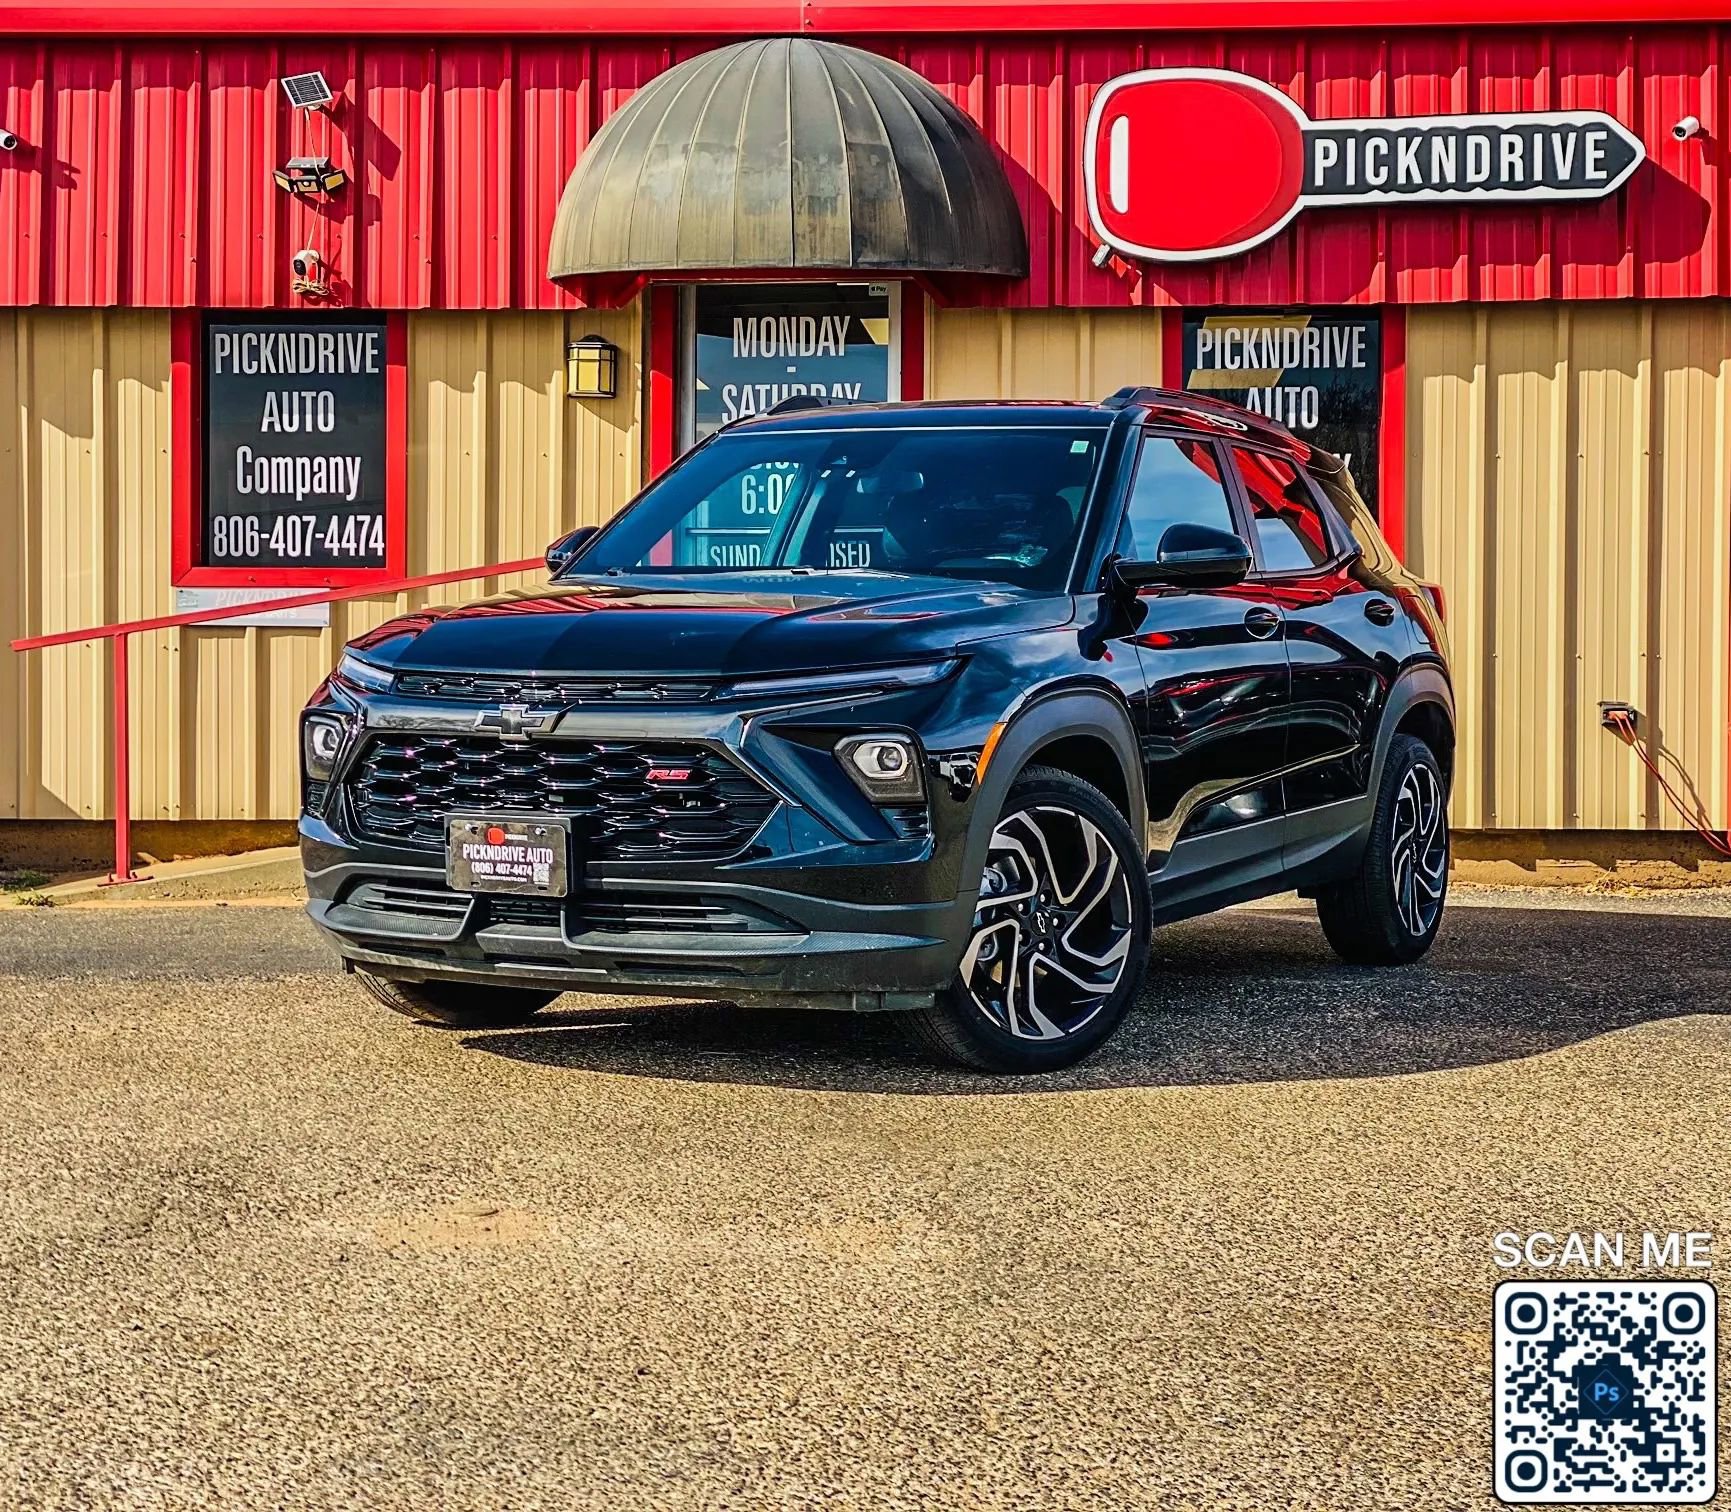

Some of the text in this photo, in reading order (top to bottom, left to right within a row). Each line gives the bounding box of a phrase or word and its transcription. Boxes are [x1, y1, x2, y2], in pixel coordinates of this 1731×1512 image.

[1314, 131, 1608, 187] PICKNDRIVE
[215, 333, 379, 374] PICKNDRIVE
[733, 315, 850, 358] MONDAY
[1196, 326, 1366, 370] PICKNDRIVE
[261, 391, 335, 432] AUTO
[1246, 385, 1319, 429] AUTO
[236, 446, 361, 501] Company
[213, 515, 385, 557] 806-407-4474
[710, 544, 760, 567] SUND
[646, 769, 690, 780] RS
[462, 843, 553, 864] PICKNDRIVE AUTO
[471, 861, 494, 875] (806)
